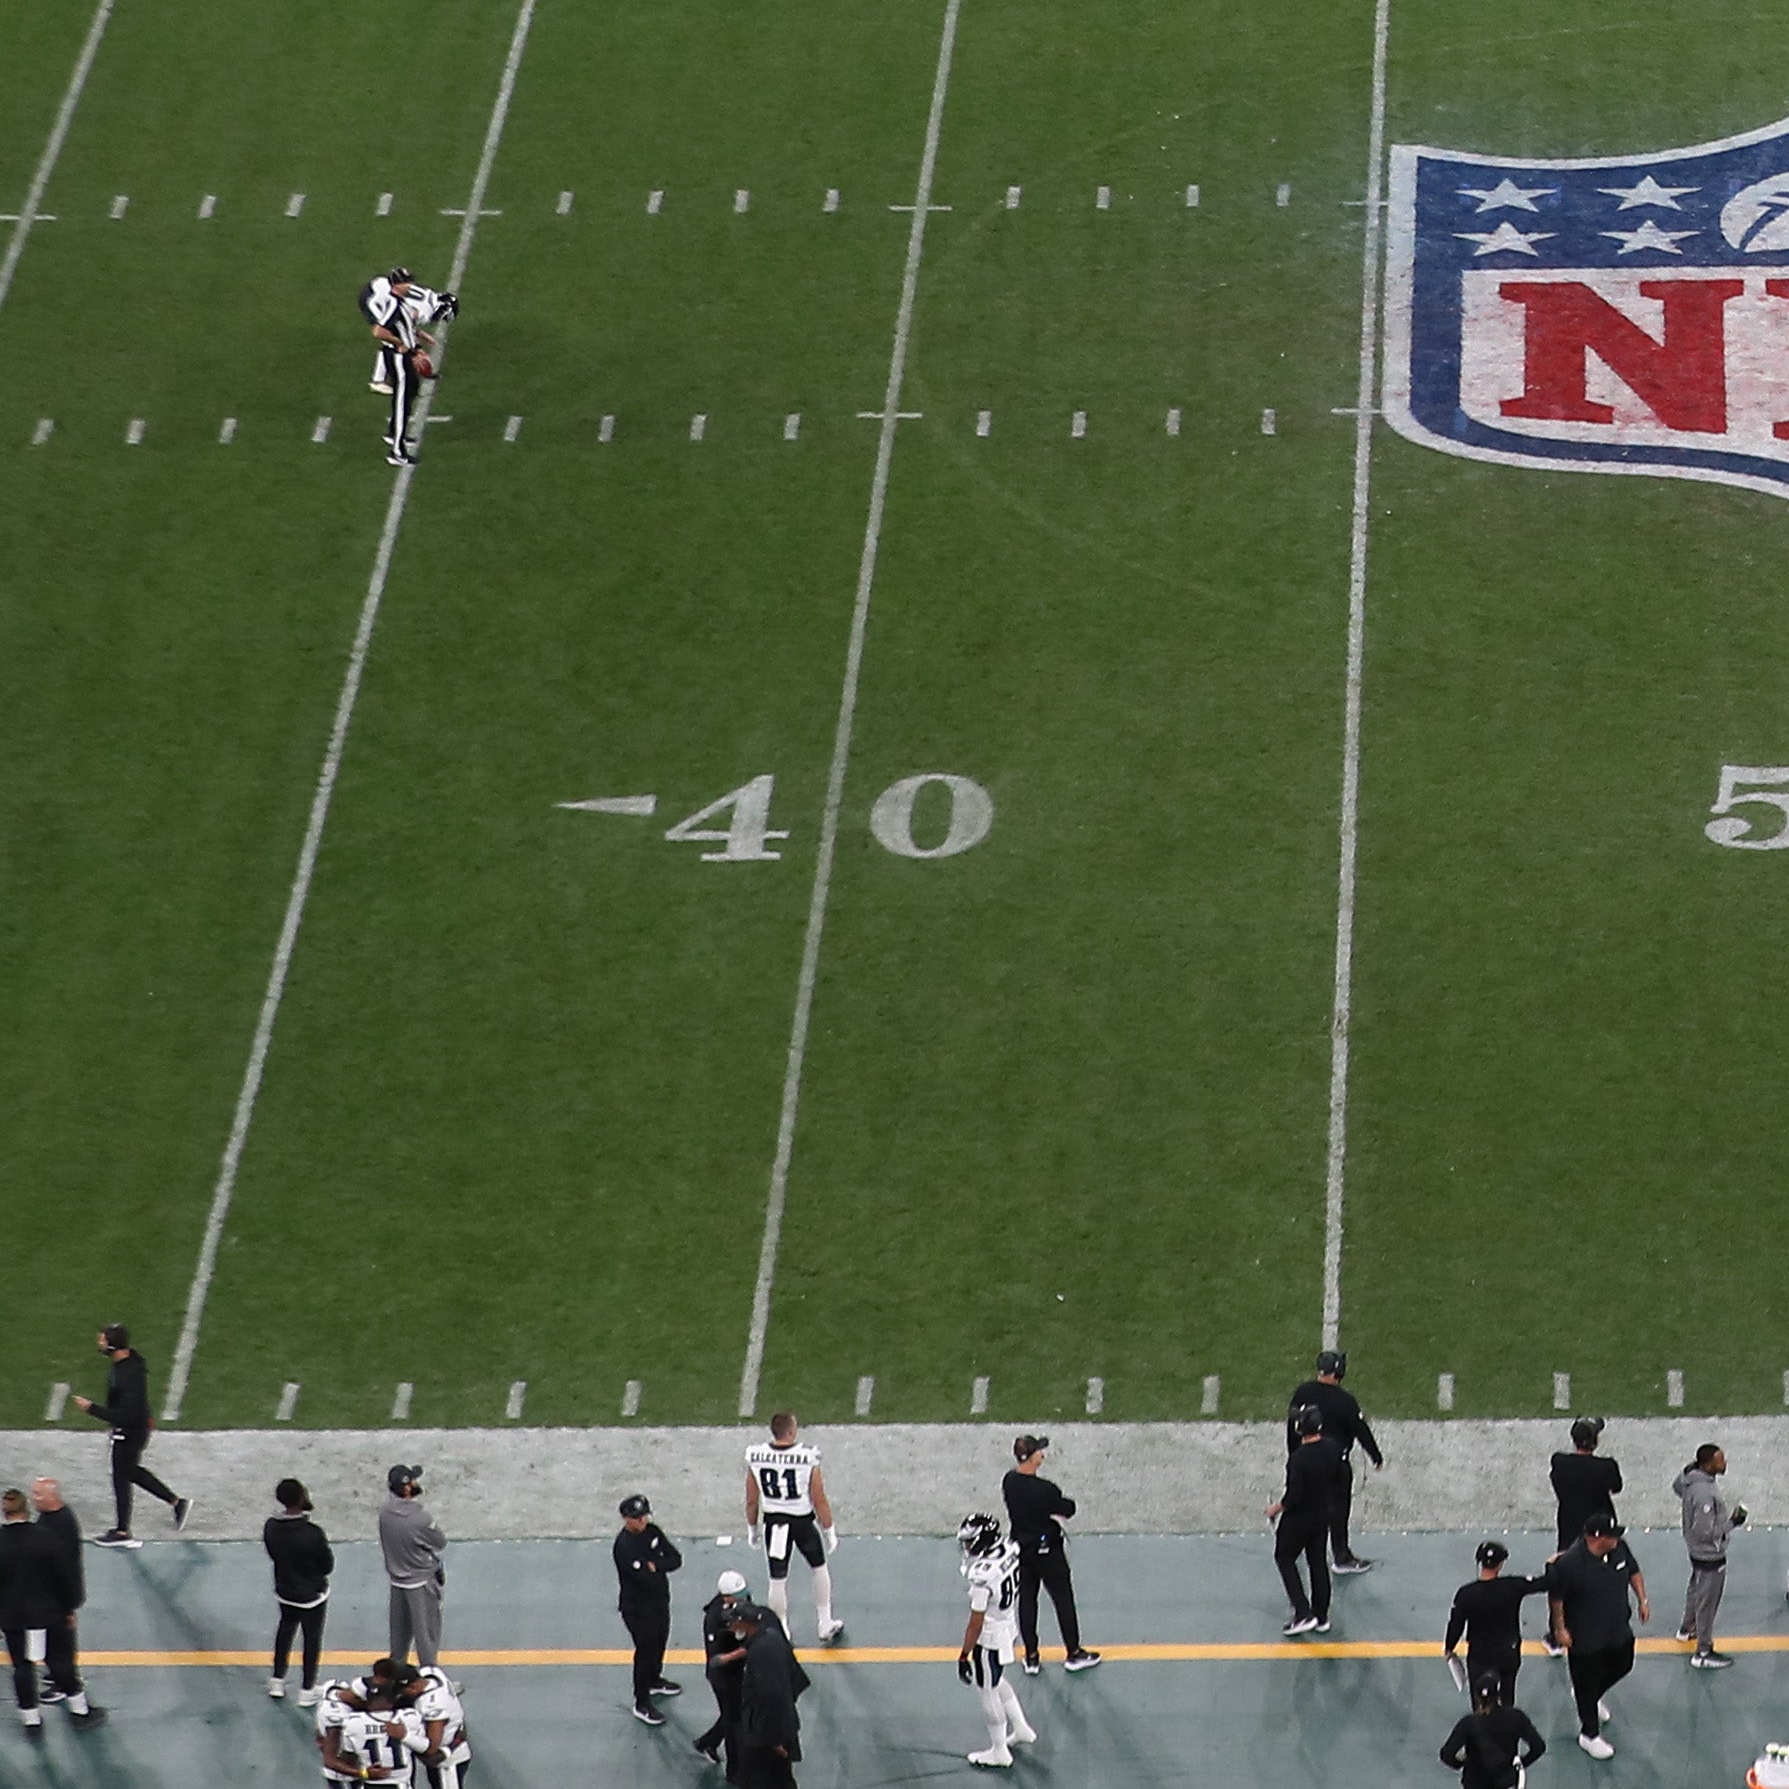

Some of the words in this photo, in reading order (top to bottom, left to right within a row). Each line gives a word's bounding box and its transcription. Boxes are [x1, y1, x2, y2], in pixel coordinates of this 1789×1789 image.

[664, 773, 994, 864] 40
[759, 1467, 801, 1501] 81
[362, 1738, 407, 1770] 11
